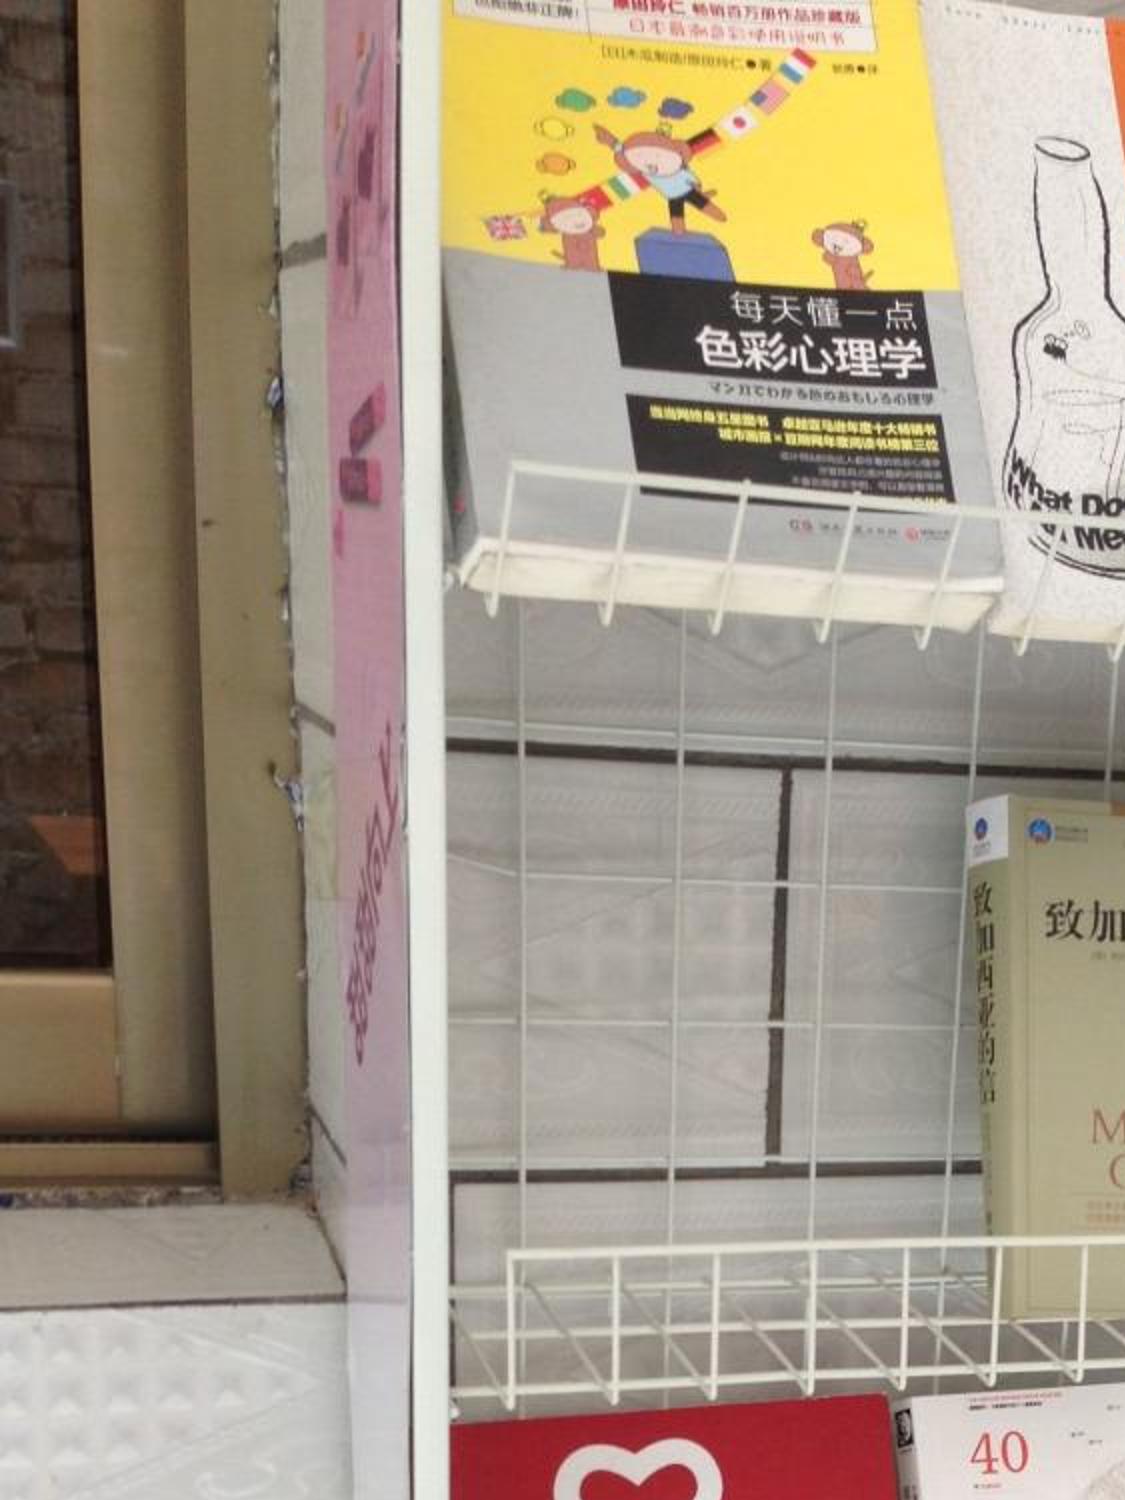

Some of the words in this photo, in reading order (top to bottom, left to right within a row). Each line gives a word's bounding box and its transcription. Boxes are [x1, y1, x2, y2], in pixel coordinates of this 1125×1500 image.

[729, 289, 919, 331] 每天懂一点
[694, 324, 927, 380] 色彩心理学
[970, 1430, 1030, 1475] 40
